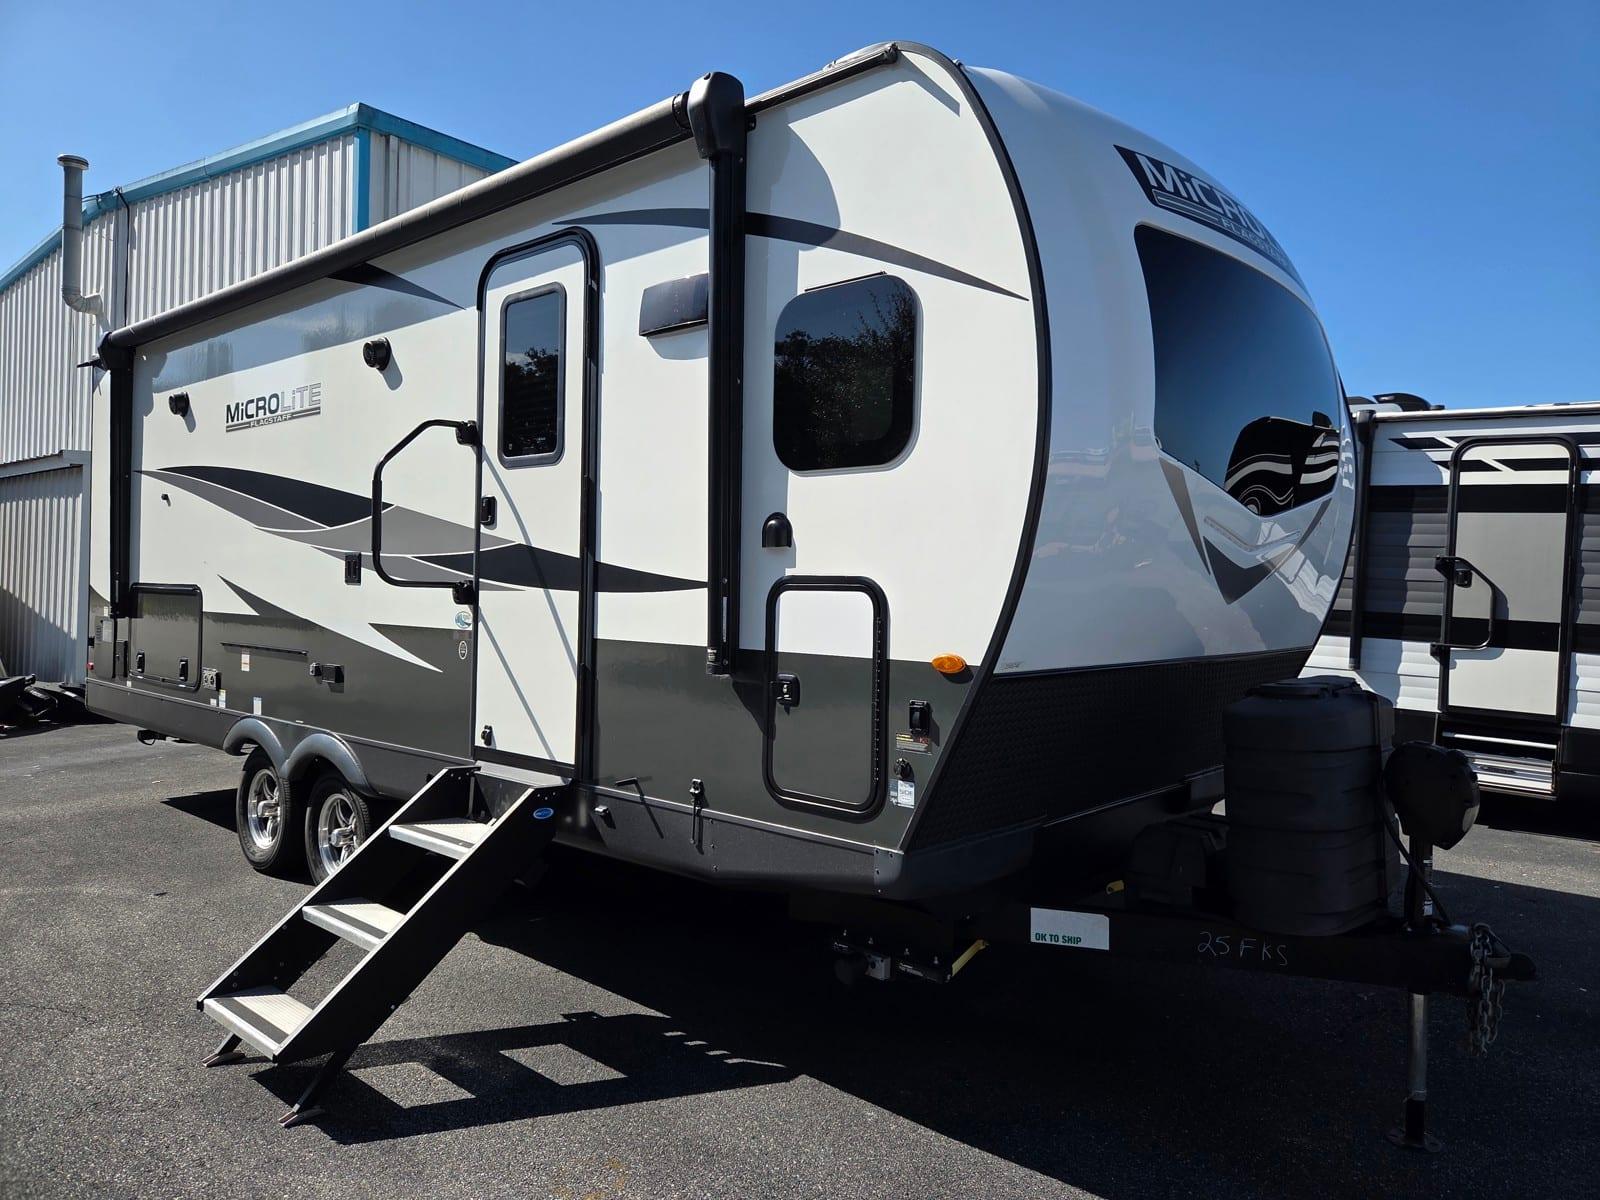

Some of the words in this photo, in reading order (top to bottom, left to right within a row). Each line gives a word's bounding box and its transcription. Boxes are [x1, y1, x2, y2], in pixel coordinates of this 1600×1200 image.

[250, 414, 292, 428] FLAGSTAFF
[1035, 932, 1047, 942] OK
[1049, 934, 1059, 943] TO
[1062, 934, 1082, 945] SHIP
